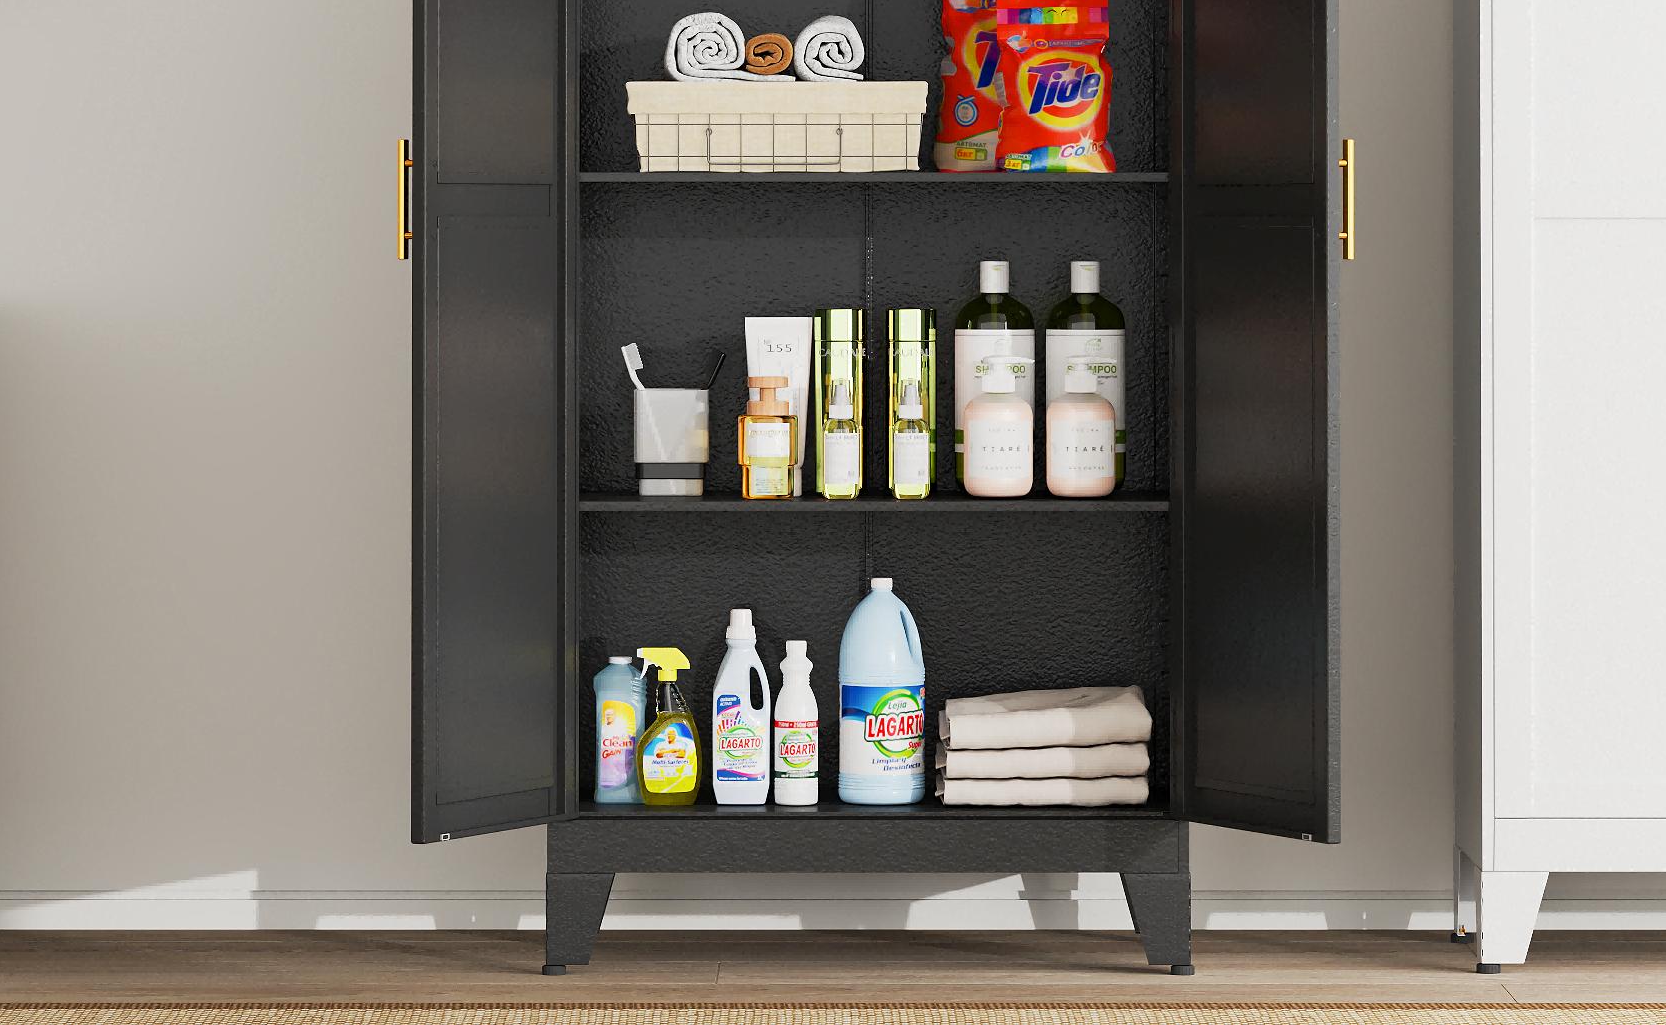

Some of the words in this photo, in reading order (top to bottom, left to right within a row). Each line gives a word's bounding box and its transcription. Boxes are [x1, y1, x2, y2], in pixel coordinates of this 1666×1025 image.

[1027, 61, 1102, 116] Tide
[766, 343, 793, 353] 155
[982, 444, 1021, 453] TIARÉ
[1066, 444, 1105, 453] TIARÉ
[867, 712, 924, 738] LAGARTO
[602, 738, 633, 748] Clean
[721, 737, 761, 750] LAGARTO
[780, 743, 816, 756] LAGARTO
